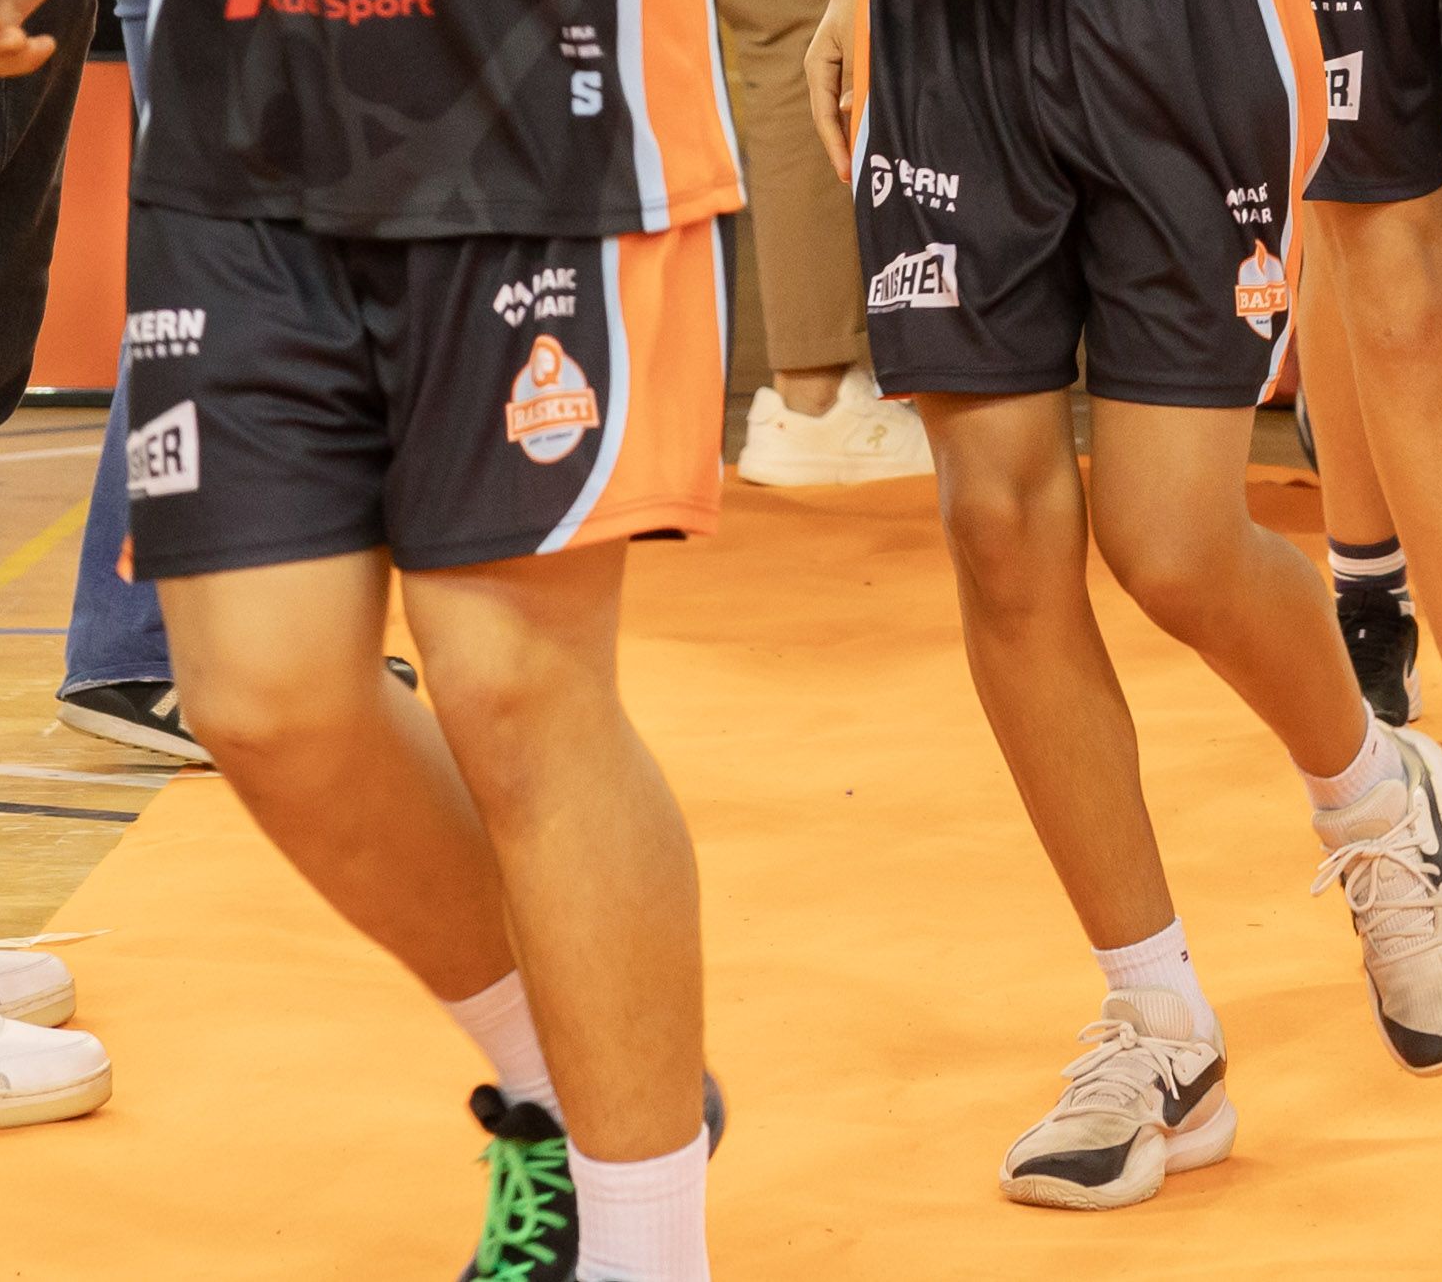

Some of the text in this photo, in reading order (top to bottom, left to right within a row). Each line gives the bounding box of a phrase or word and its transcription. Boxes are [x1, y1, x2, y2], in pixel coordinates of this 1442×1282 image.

[1310, 0, 1363, 12] ARMA
[570, 70, 604, 116] S
[894, 158, 960, 199] ERN
